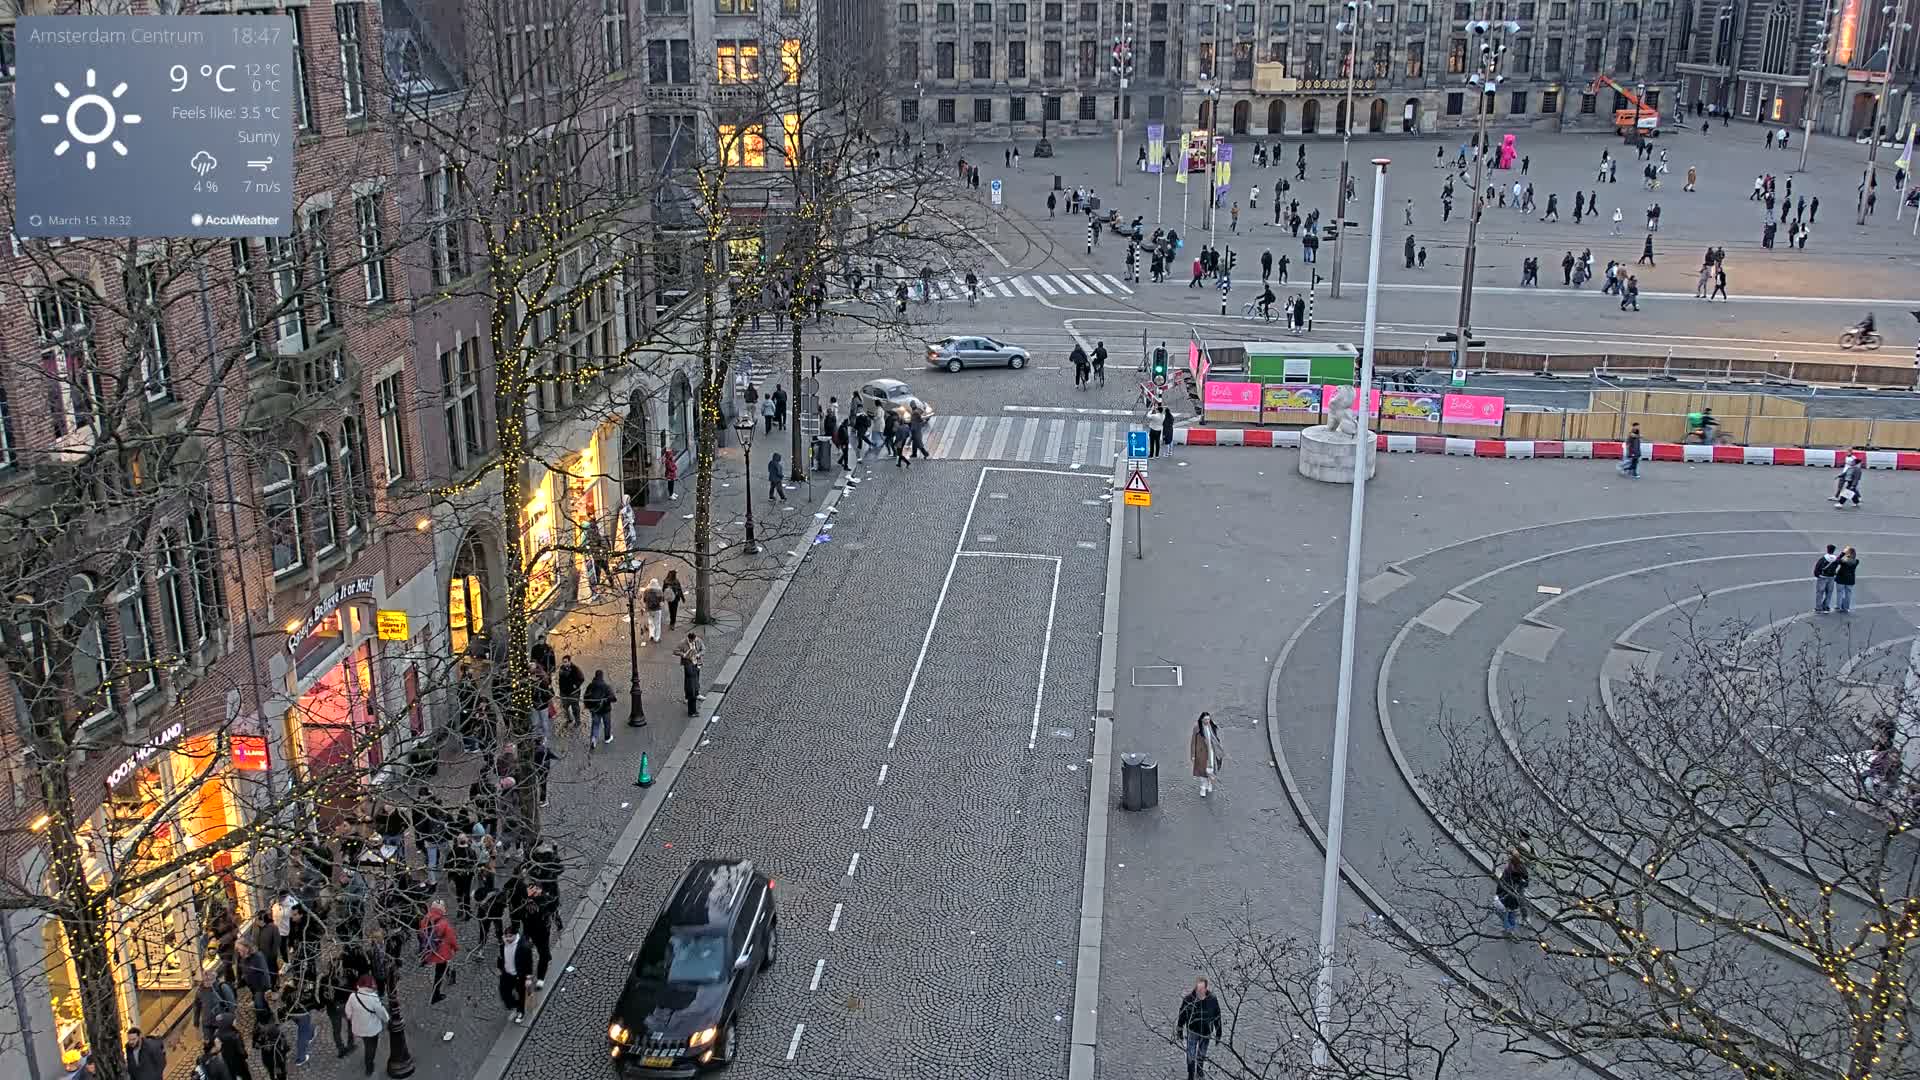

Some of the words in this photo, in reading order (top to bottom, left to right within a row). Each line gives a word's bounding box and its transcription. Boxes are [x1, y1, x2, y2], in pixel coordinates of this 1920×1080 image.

[313, 591, 340, 621] Believe
[340, 585, 347, 599] It
[347, 584, 356, 595] or
[356, 578, 373, 593] Not!
[107, 755, 137, 788] 100%
